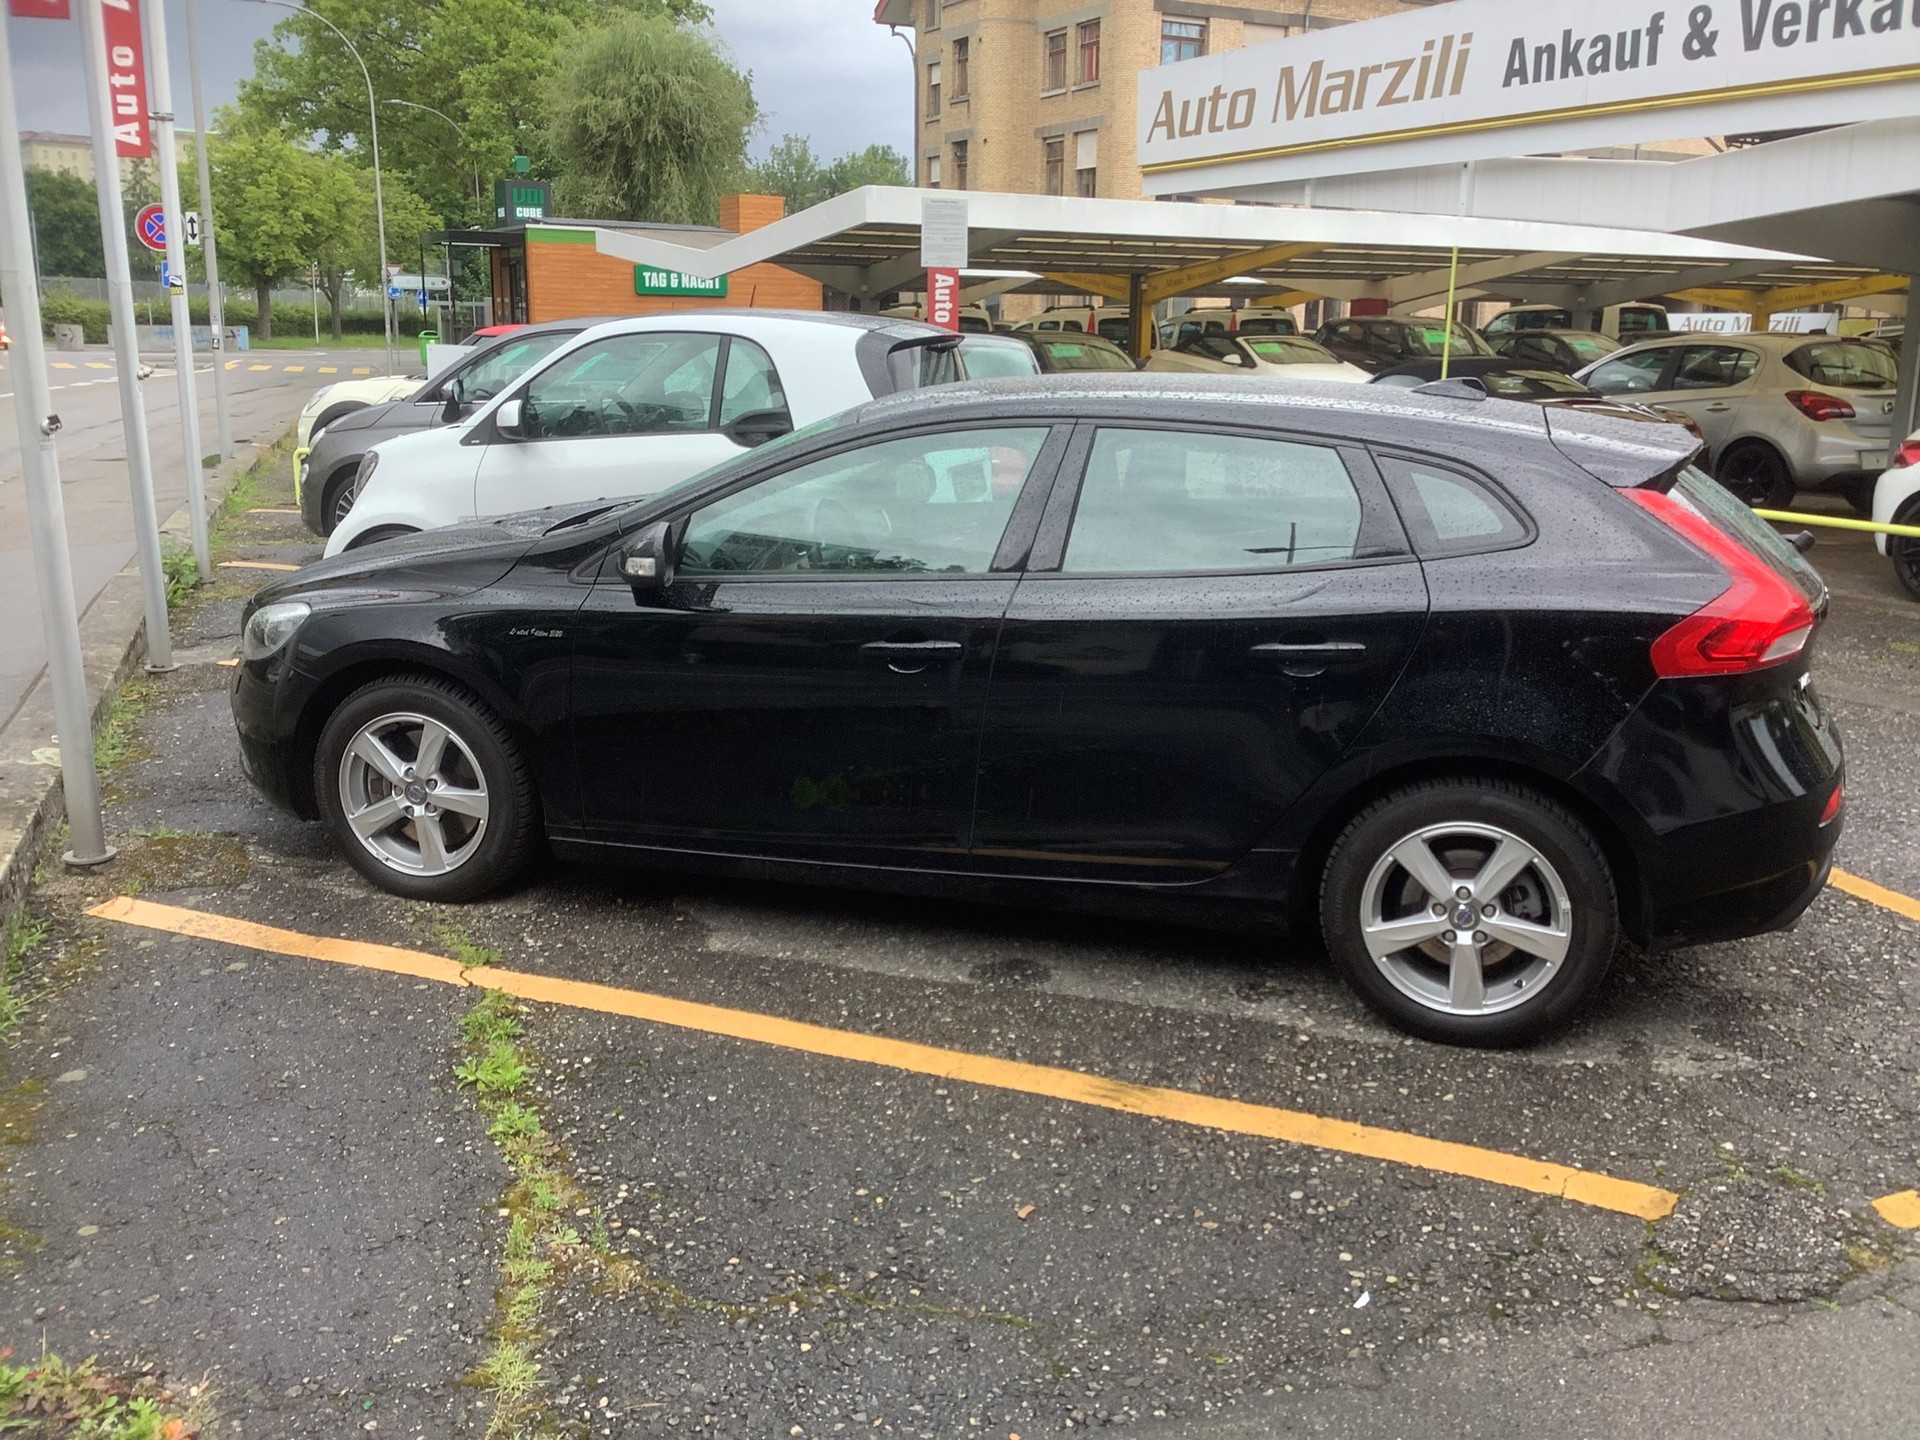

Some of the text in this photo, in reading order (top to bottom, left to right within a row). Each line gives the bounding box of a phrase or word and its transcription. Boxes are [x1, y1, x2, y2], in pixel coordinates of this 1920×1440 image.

[1146, 0, 1920, 143] Auto Marzili Ankauf & Verka
[110, 46, 141, 147] Auto
[516, 207, 543, 218] CUBE
[643, 271, 667, 288] TAG
[681, 273, 720, 289] NACHT
[934, 273, 955, 323] Auto
[1679, 316, 1801, 332] Auto Mzili
